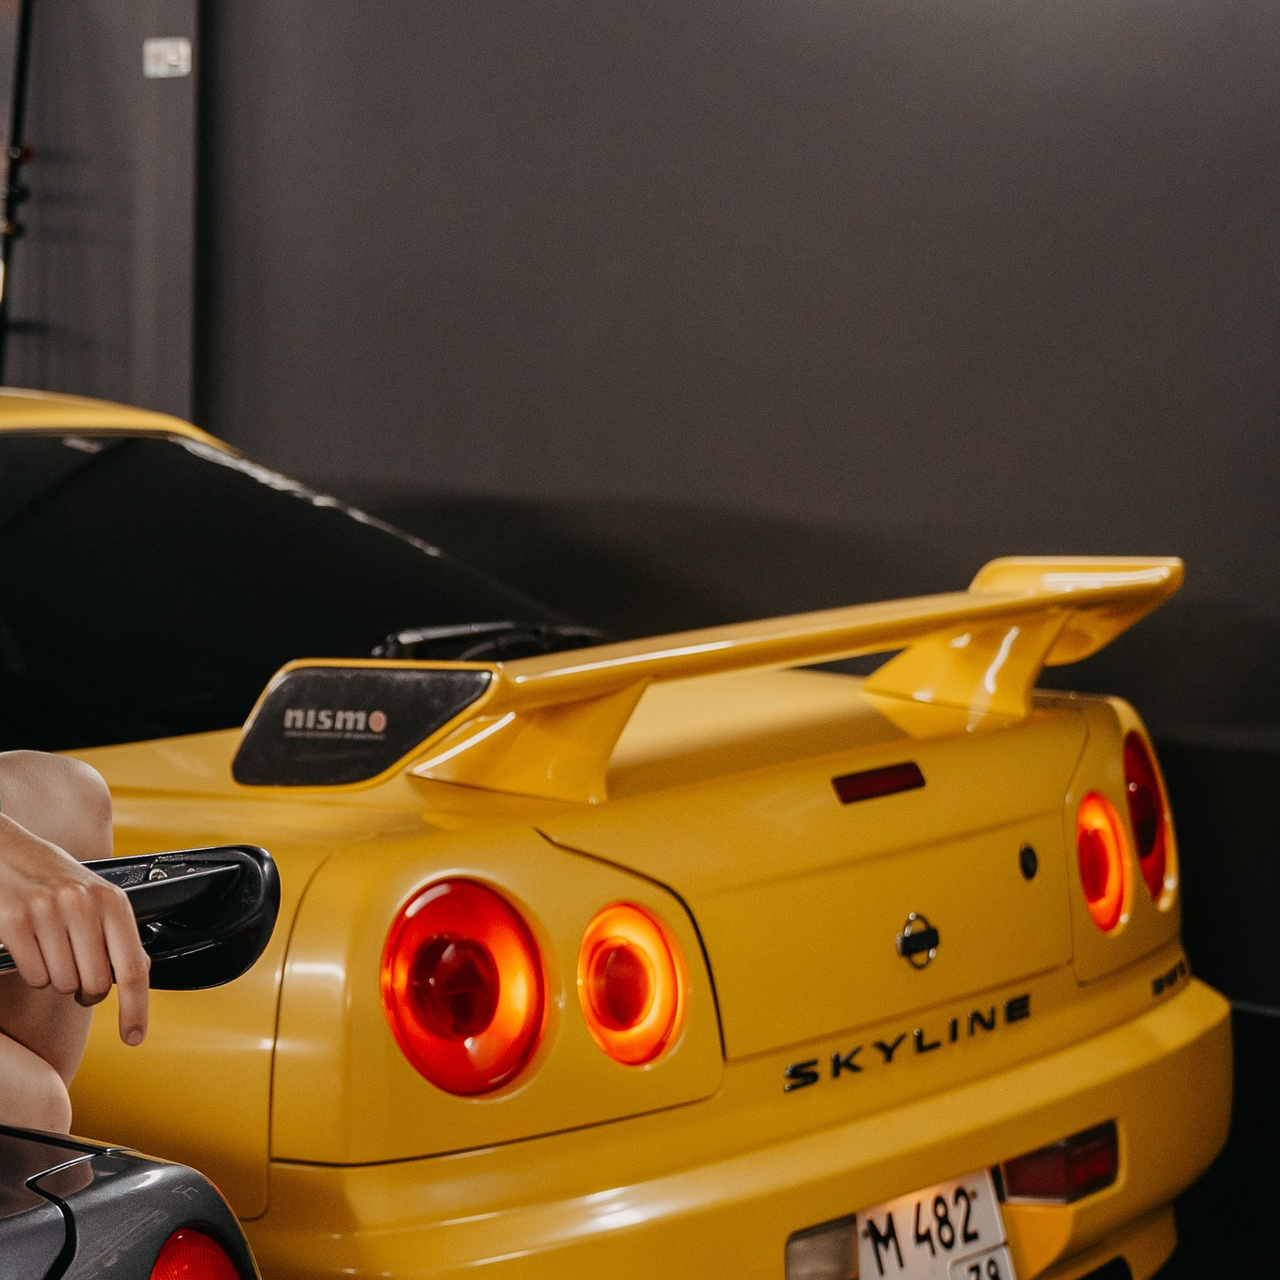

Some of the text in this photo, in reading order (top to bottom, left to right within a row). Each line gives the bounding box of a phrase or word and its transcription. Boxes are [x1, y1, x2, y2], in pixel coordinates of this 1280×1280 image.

[283, 708, 387, 733] nismo
[784, 993, 1030, 1093] SKYLINE
[914, 1186, 979, 1256] 482
